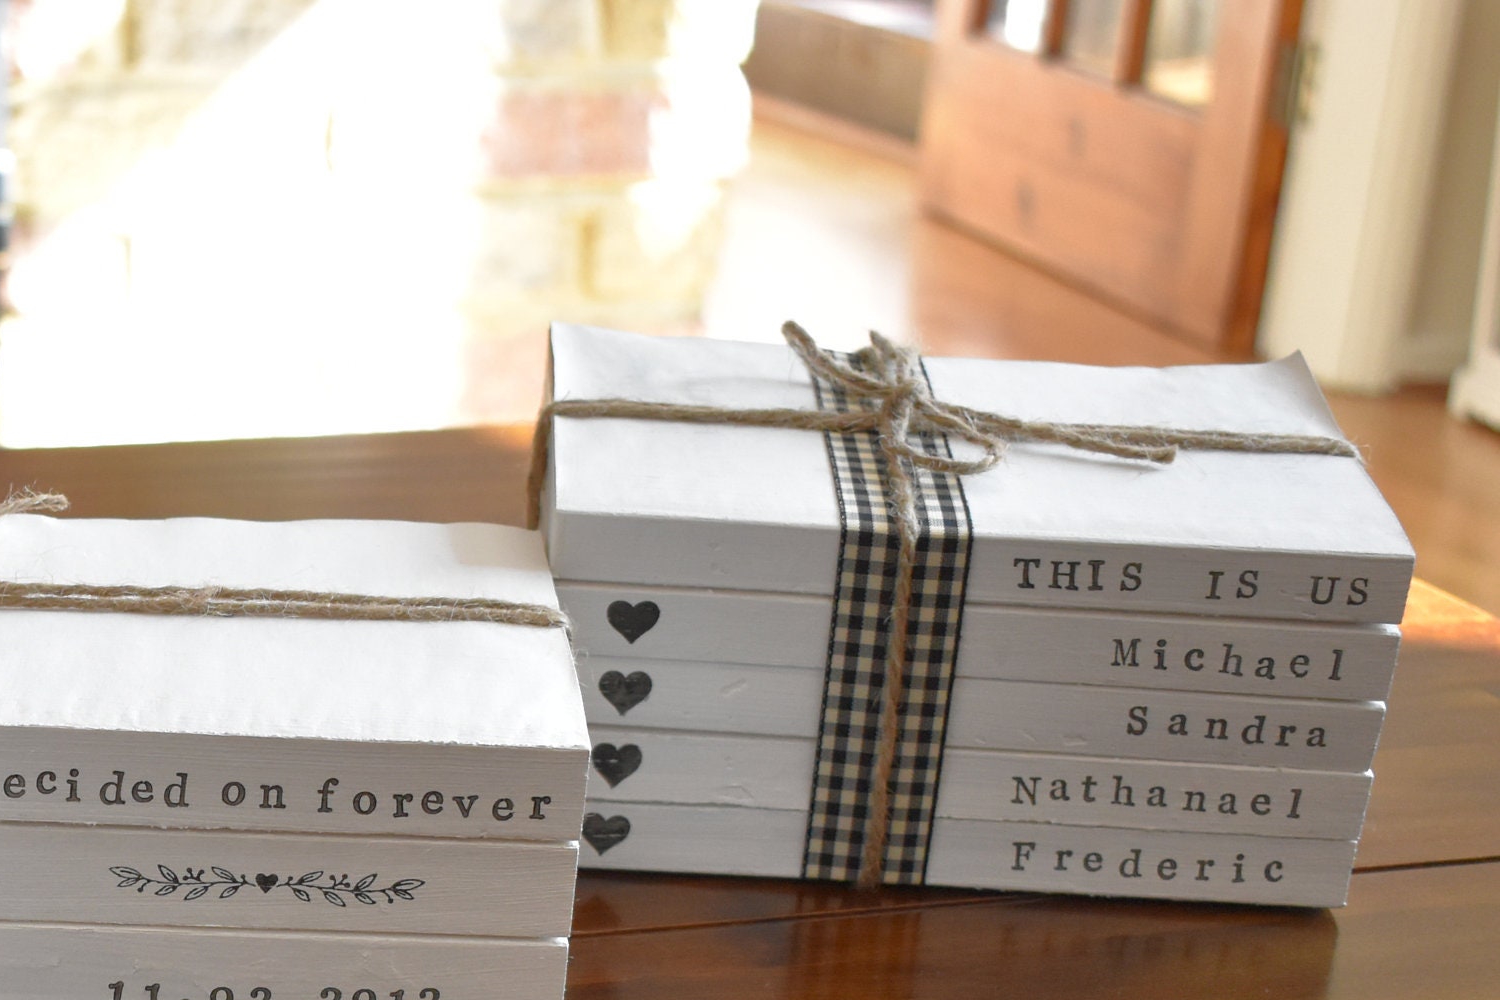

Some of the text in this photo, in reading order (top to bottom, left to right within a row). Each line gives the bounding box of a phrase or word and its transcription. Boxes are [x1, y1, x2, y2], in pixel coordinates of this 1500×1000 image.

[1013, 557, 1370, 606] THIS IS US
[1110, 637, 1344, 681] Michael
[1126, 705, 1328, 748] Sandra
[221, 779, 287, 810] on
[316, 778, 553, 821] forever
[1010, 774, 1303, 820] Nathanael
[1010, 841, 1285, 884] Frederic
